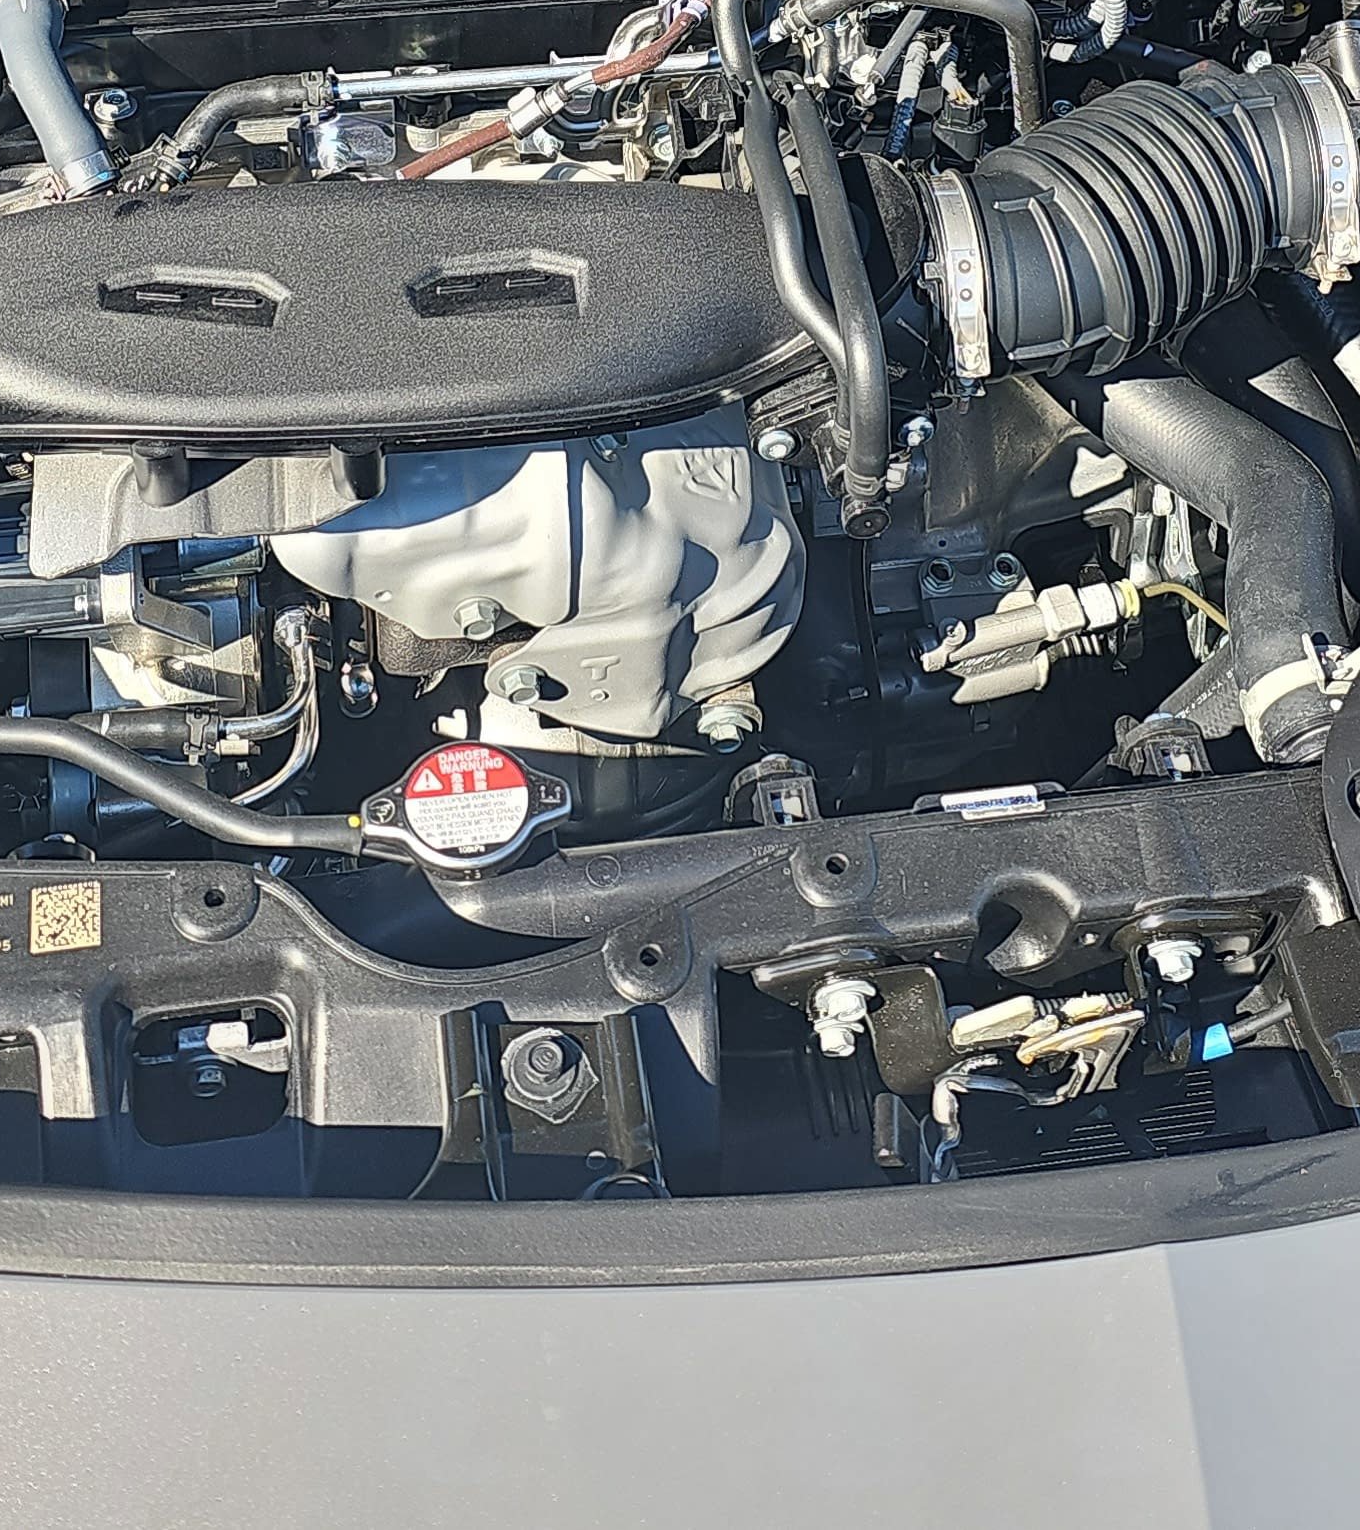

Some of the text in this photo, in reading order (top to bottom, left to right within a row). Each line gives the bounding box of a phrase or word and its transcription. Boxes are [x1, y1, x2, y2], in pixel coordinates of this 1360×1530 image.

[437, 748, 490, 764] DANGER
[439, 757, 504, 774] WARNUNG
[496, 790, 513, 798] HOT
